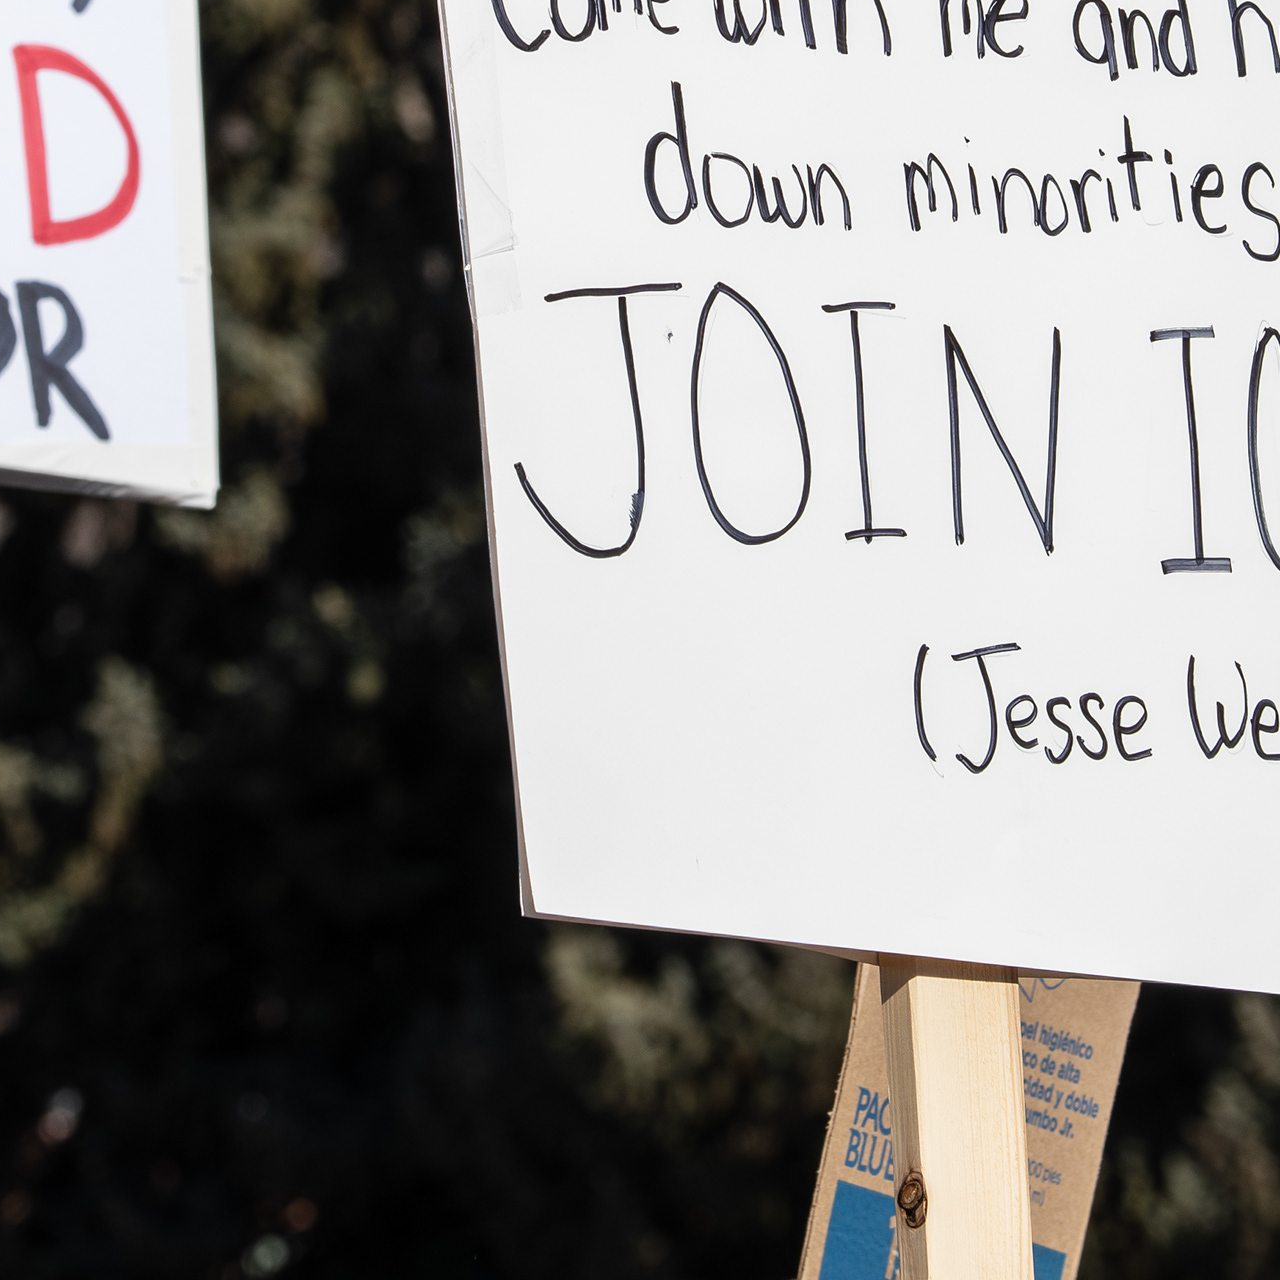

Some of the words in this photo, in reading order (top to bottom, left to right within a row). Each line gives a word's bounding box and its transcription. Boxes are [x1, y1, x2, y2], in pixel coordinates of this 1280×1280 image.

[645, 80, 854, 232] down
[515, 281, 1061, 558] JOIN
[913, 641, 1153, 776] (Jesse
[1021, 1021, 1039, 1042] pel
[1038, 1024, 1093, 1060] higiénico
[1022, 1049, 1038, 1070] co
[1040, 1054, 1056, 1076] de
[1057, 1061, 1081, 1085] alta
[854, 1086, 892, 1137] PAC
[1024, 1075, 1055, 1104] cidad
[1053, 1090, 1064, 1109] y
[1065, 1091, 1099, 1119] doble
[1026, 1107, 1058, 1133] umbo
[1059, 1117, 1075, 1139] Jr.
